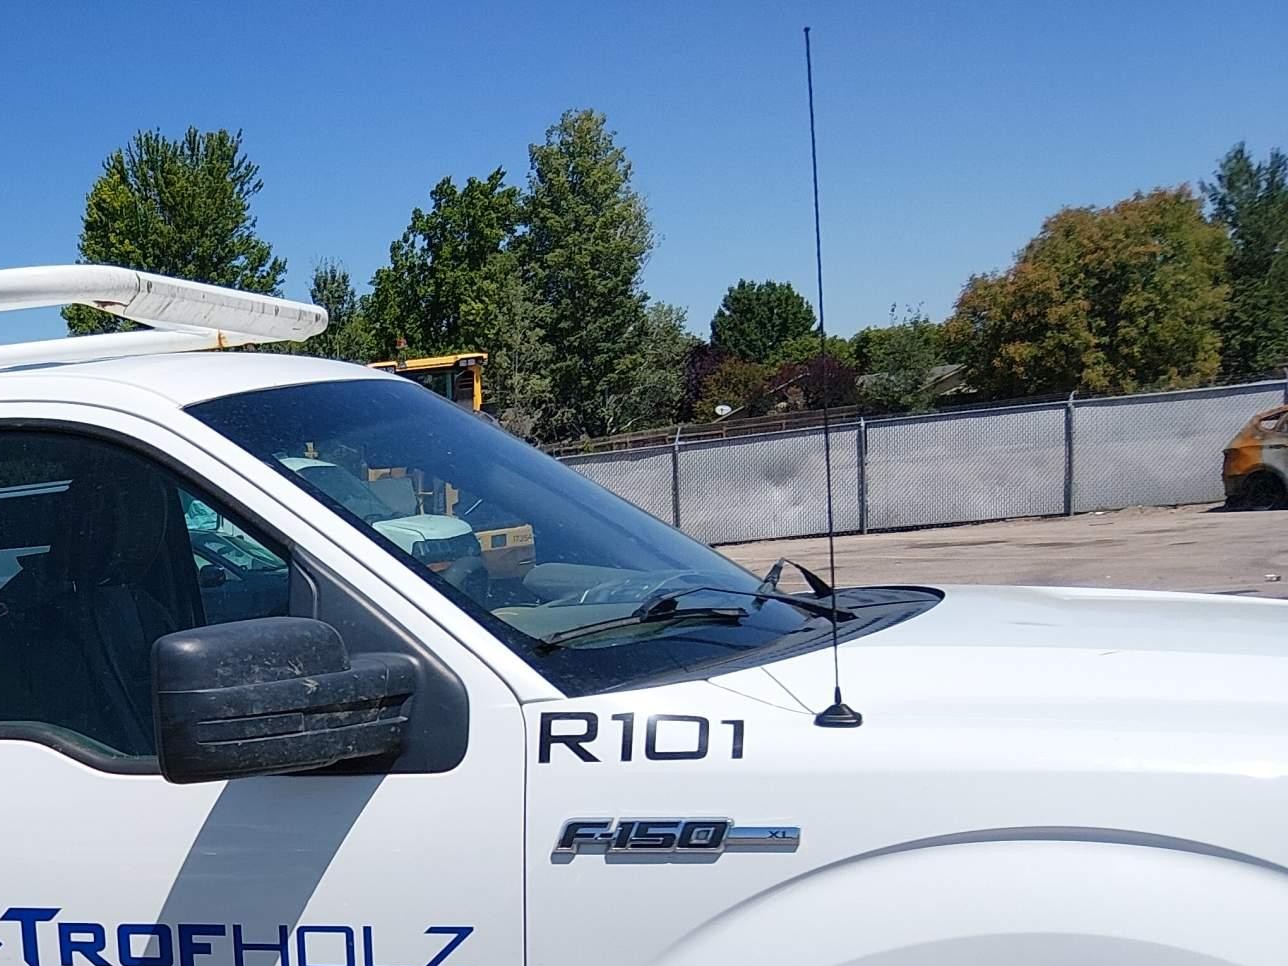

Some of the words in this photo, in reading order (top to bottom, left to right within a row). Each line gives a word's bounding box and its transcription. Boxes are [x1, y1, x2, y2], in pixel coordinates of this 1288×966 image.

[538, 712, 745, 763] R101
[551, 817, 733, 858] F-150
[768, 830, 793, 840] XL
